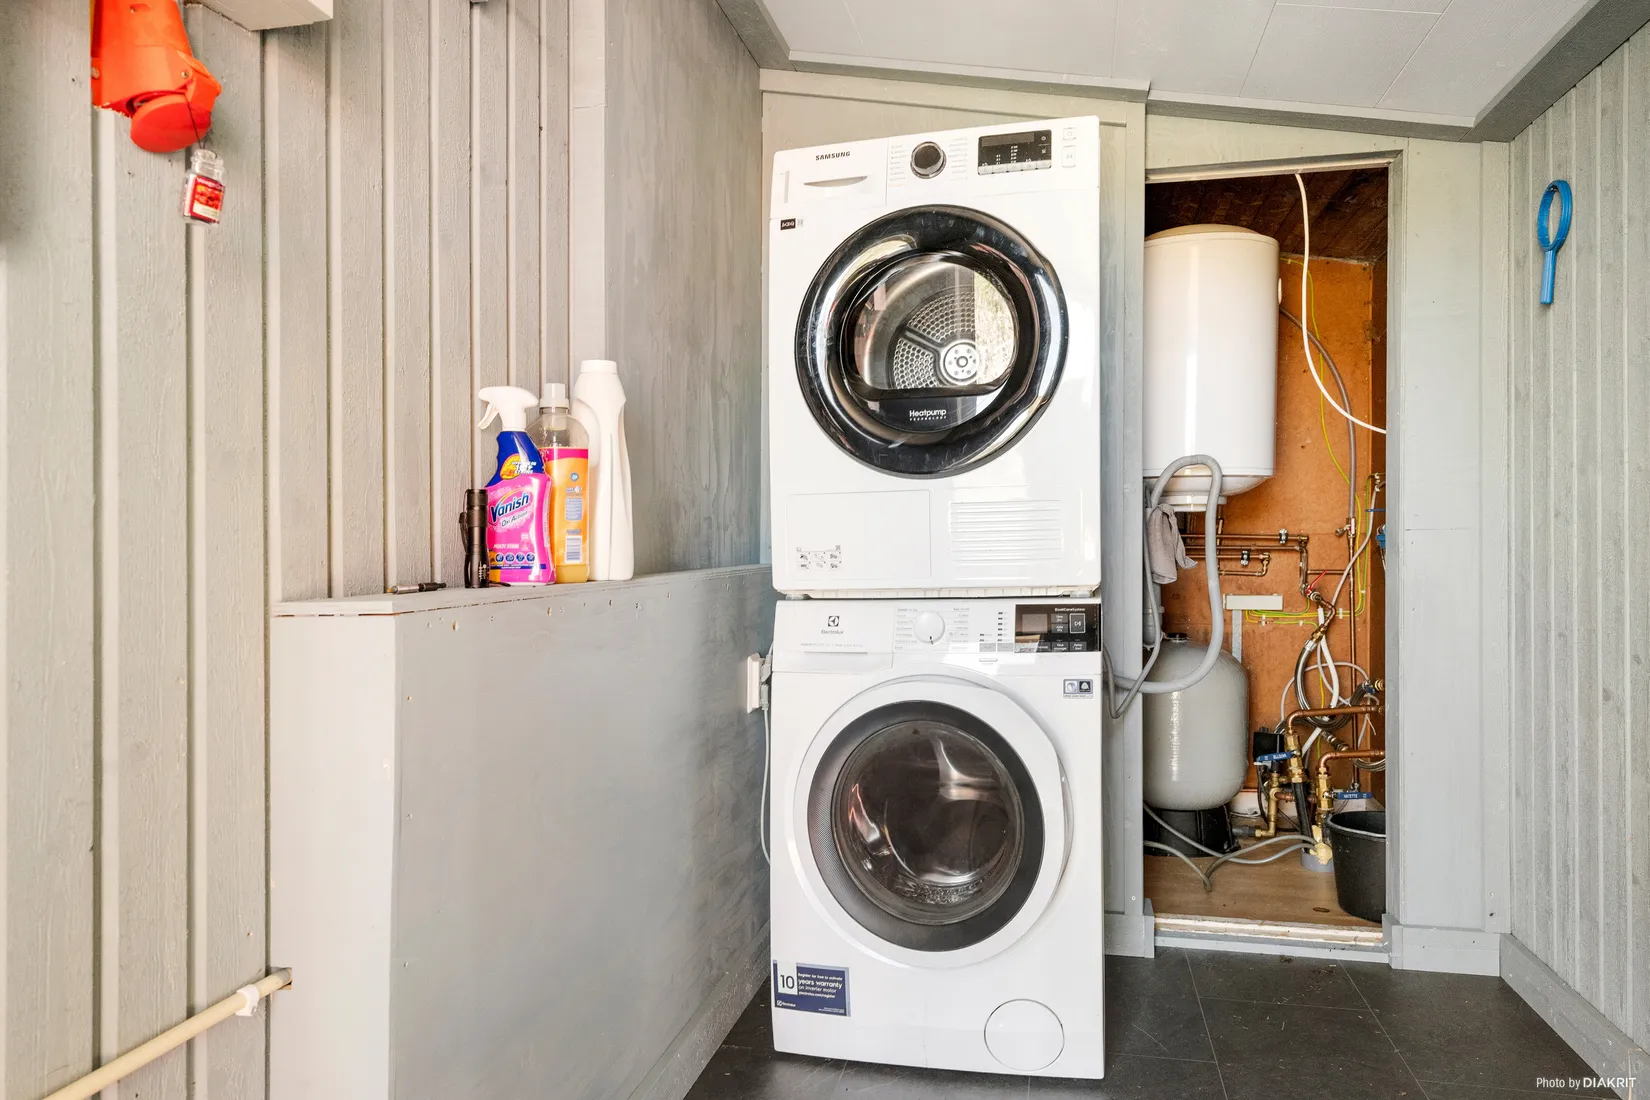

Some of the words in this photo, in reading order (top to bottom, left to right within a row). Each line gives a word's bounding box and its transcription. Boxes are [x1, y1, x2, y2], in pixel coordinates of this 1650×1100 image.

[815, 151, 851, 161] SAMSUNG
[909, 409, 947, 417] Heatpump
[491, 492, 529, 522] Vanish
[501, 518, 510, 527] Oxi
[780, 974, 795, 989] 10
[815, 981, 843, 990] warranty
